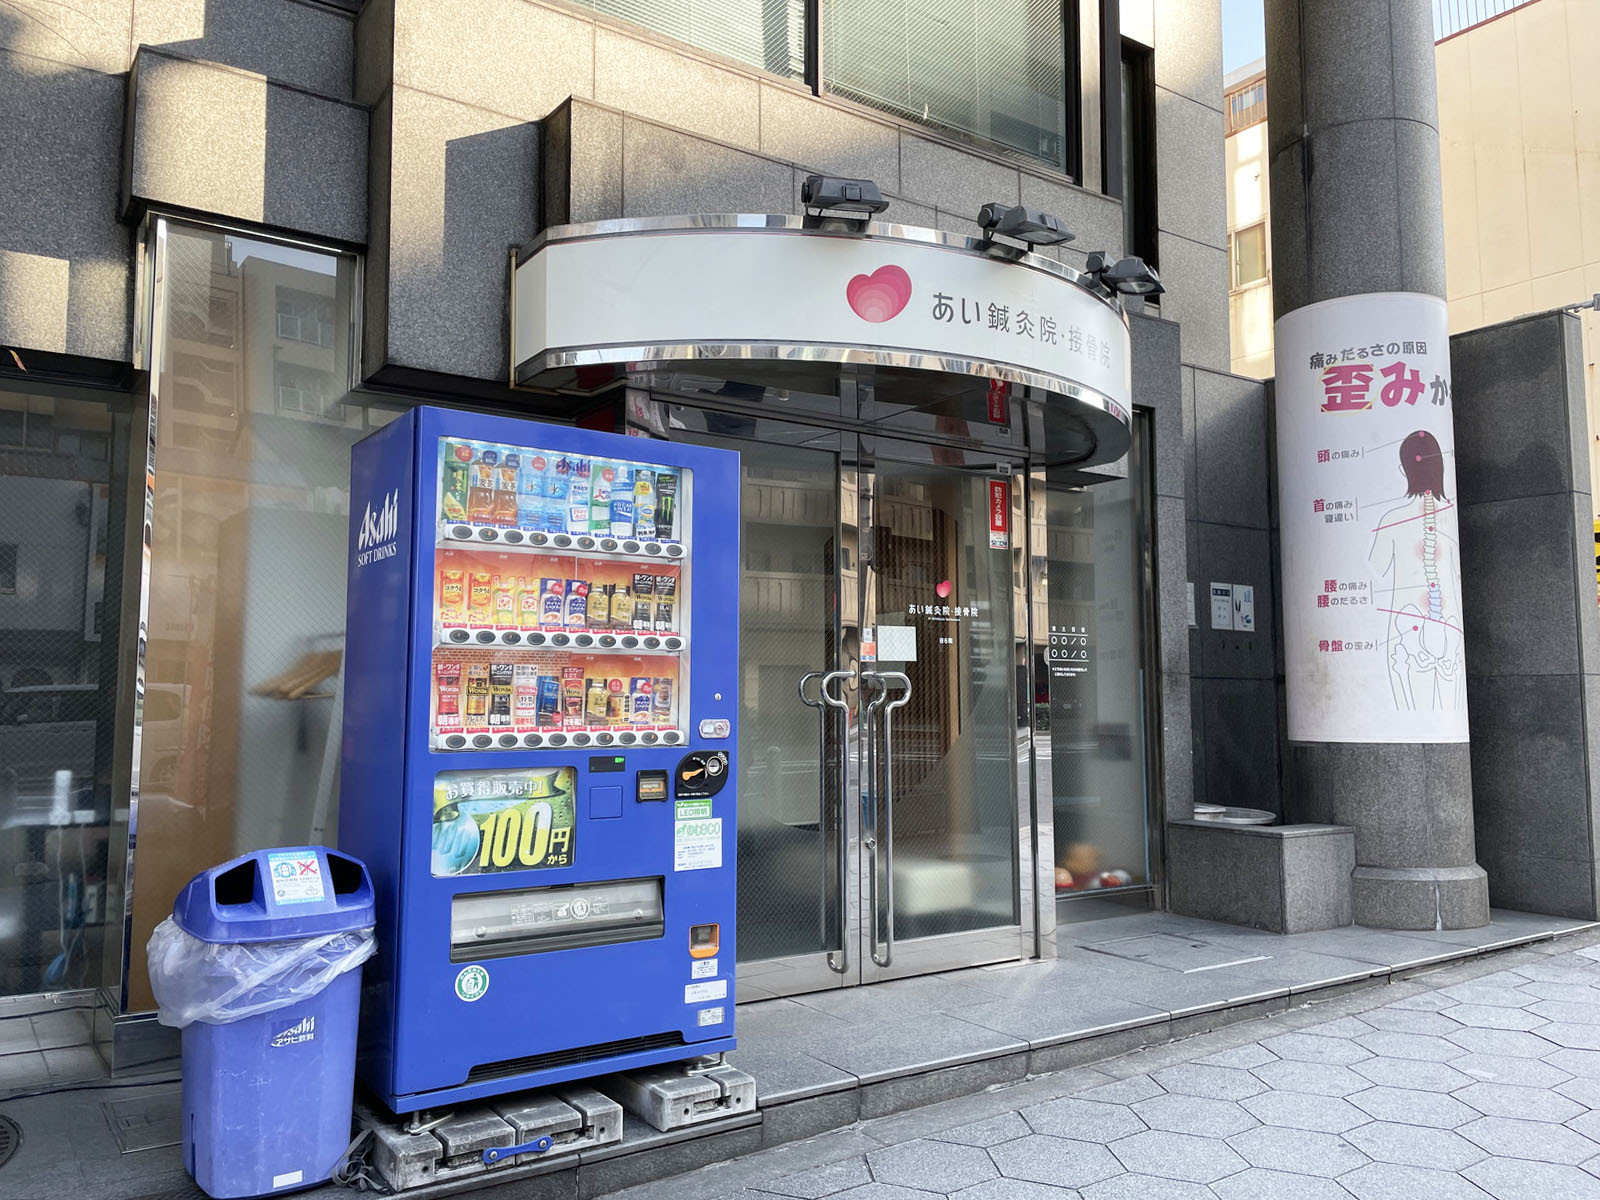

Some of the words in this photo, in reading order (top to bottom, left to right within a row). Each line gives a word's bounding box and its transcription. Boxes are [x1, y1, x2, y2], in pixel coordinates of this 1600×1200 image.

[932, 291, 1112, 369] あい鍼灸院・接骨院
[1317, 449, 1360, 463] 頭の痛み
[1313, 498, 1353, 512] 首の痛み
[358, 488, 399, 551] Asahi
[358, 549, 373, 568] SOFT
[373, 541, 397, 562] DRINKS
[1324, 579, 1368, 593] 腰の痛み
[1317, 594, 1368, 608] 腰のだるさ
[908, 603, 979, 617] あい鍼灸院・接骨院
[546, 854, 568, 865] から
[272, 1016, 315, 1040] Asahi
[275, 1032, 315, 1046] アサヒ飲料
